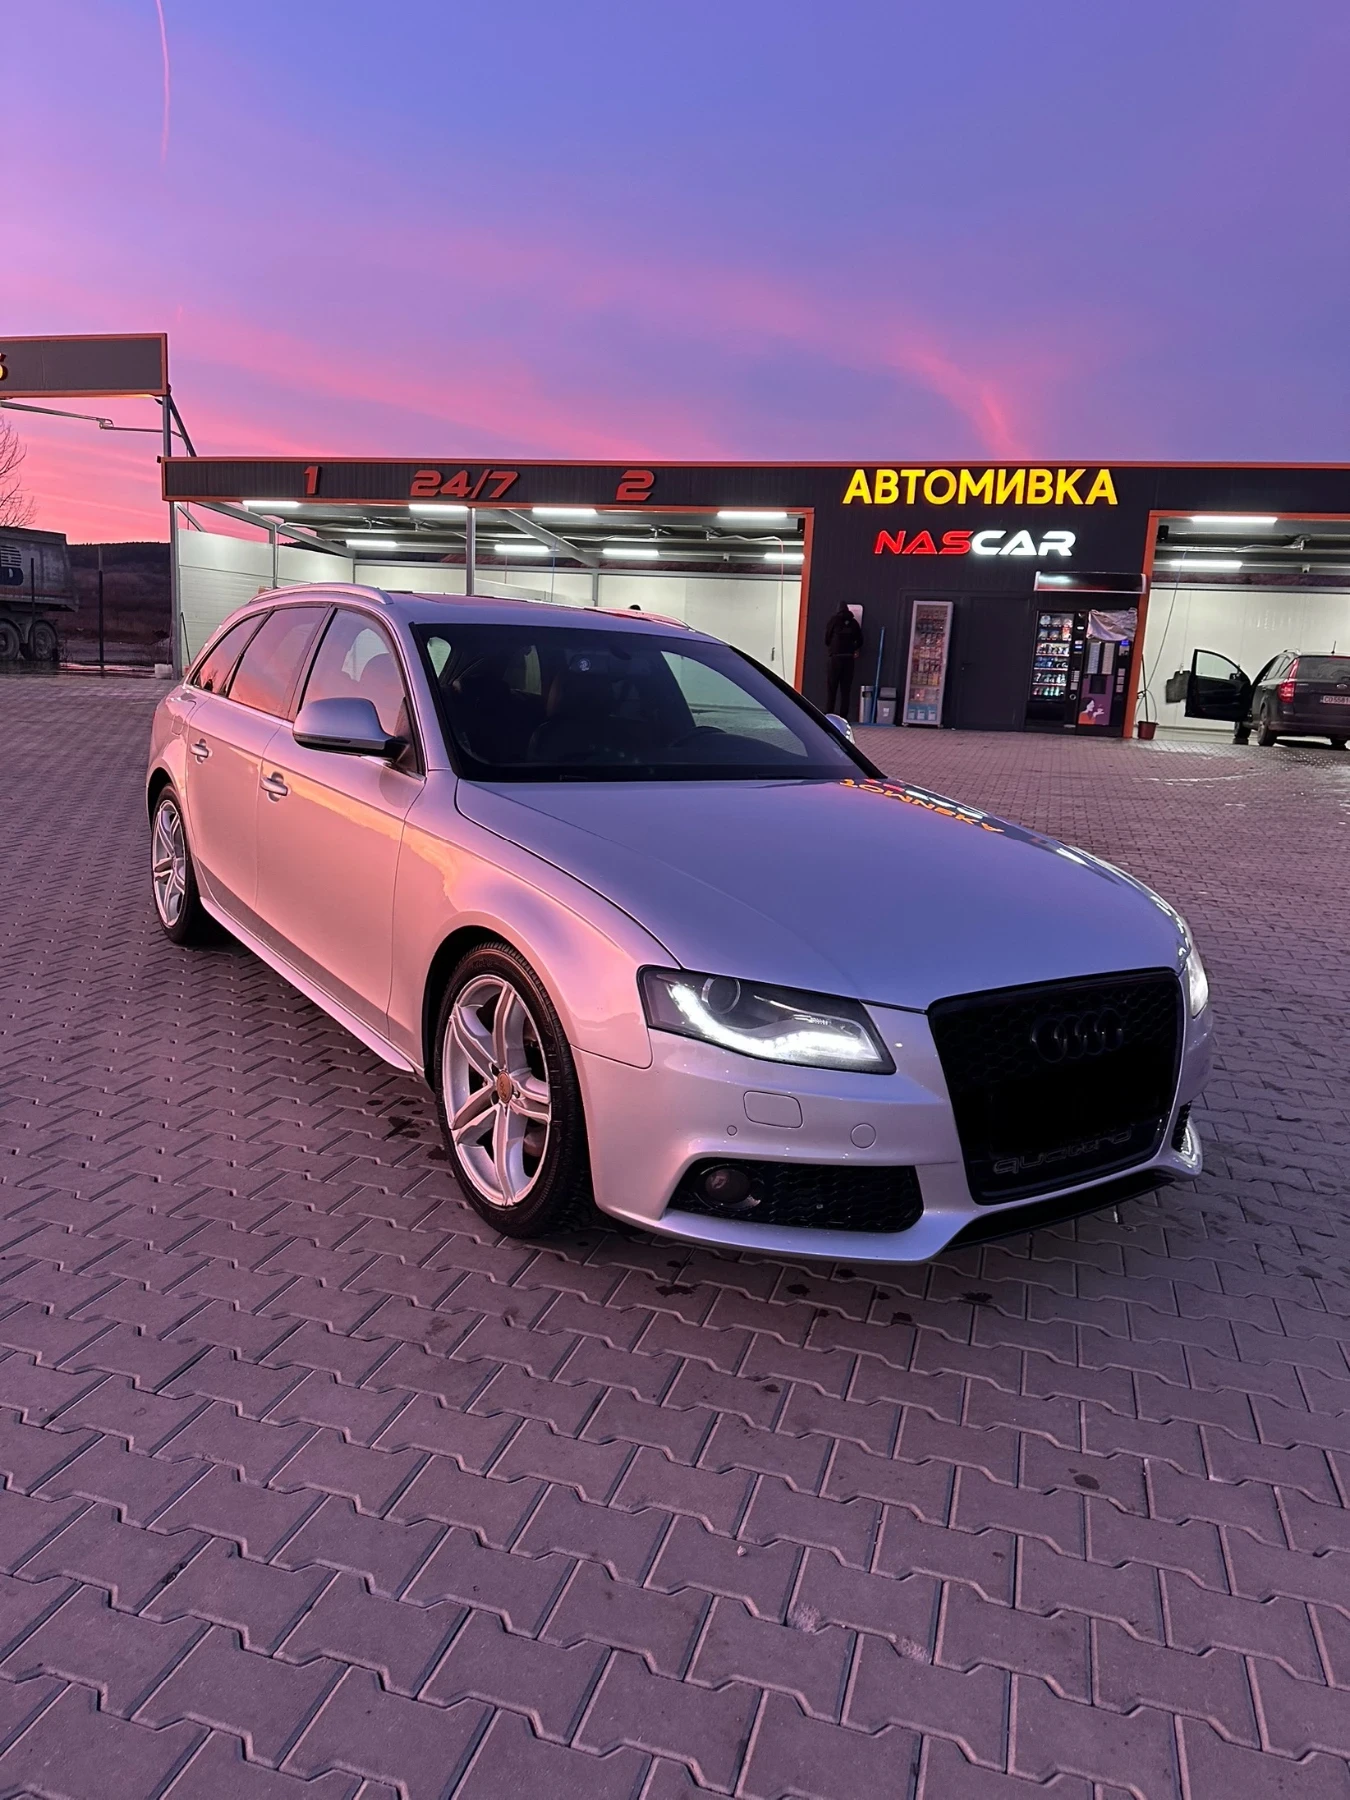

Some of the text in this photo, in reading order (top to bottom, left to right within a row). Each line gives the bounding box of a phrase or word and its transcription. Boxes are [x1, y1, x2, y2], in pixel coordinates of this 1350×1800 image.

[303, 465, 321, 495] 1
[410, 468, 520, 499] 24/7
[615, 469, 656, 501] 2
[842, 468, 1118, 505] АВТОМИВКА
[874, 529, 1077, 557] NASCAR
